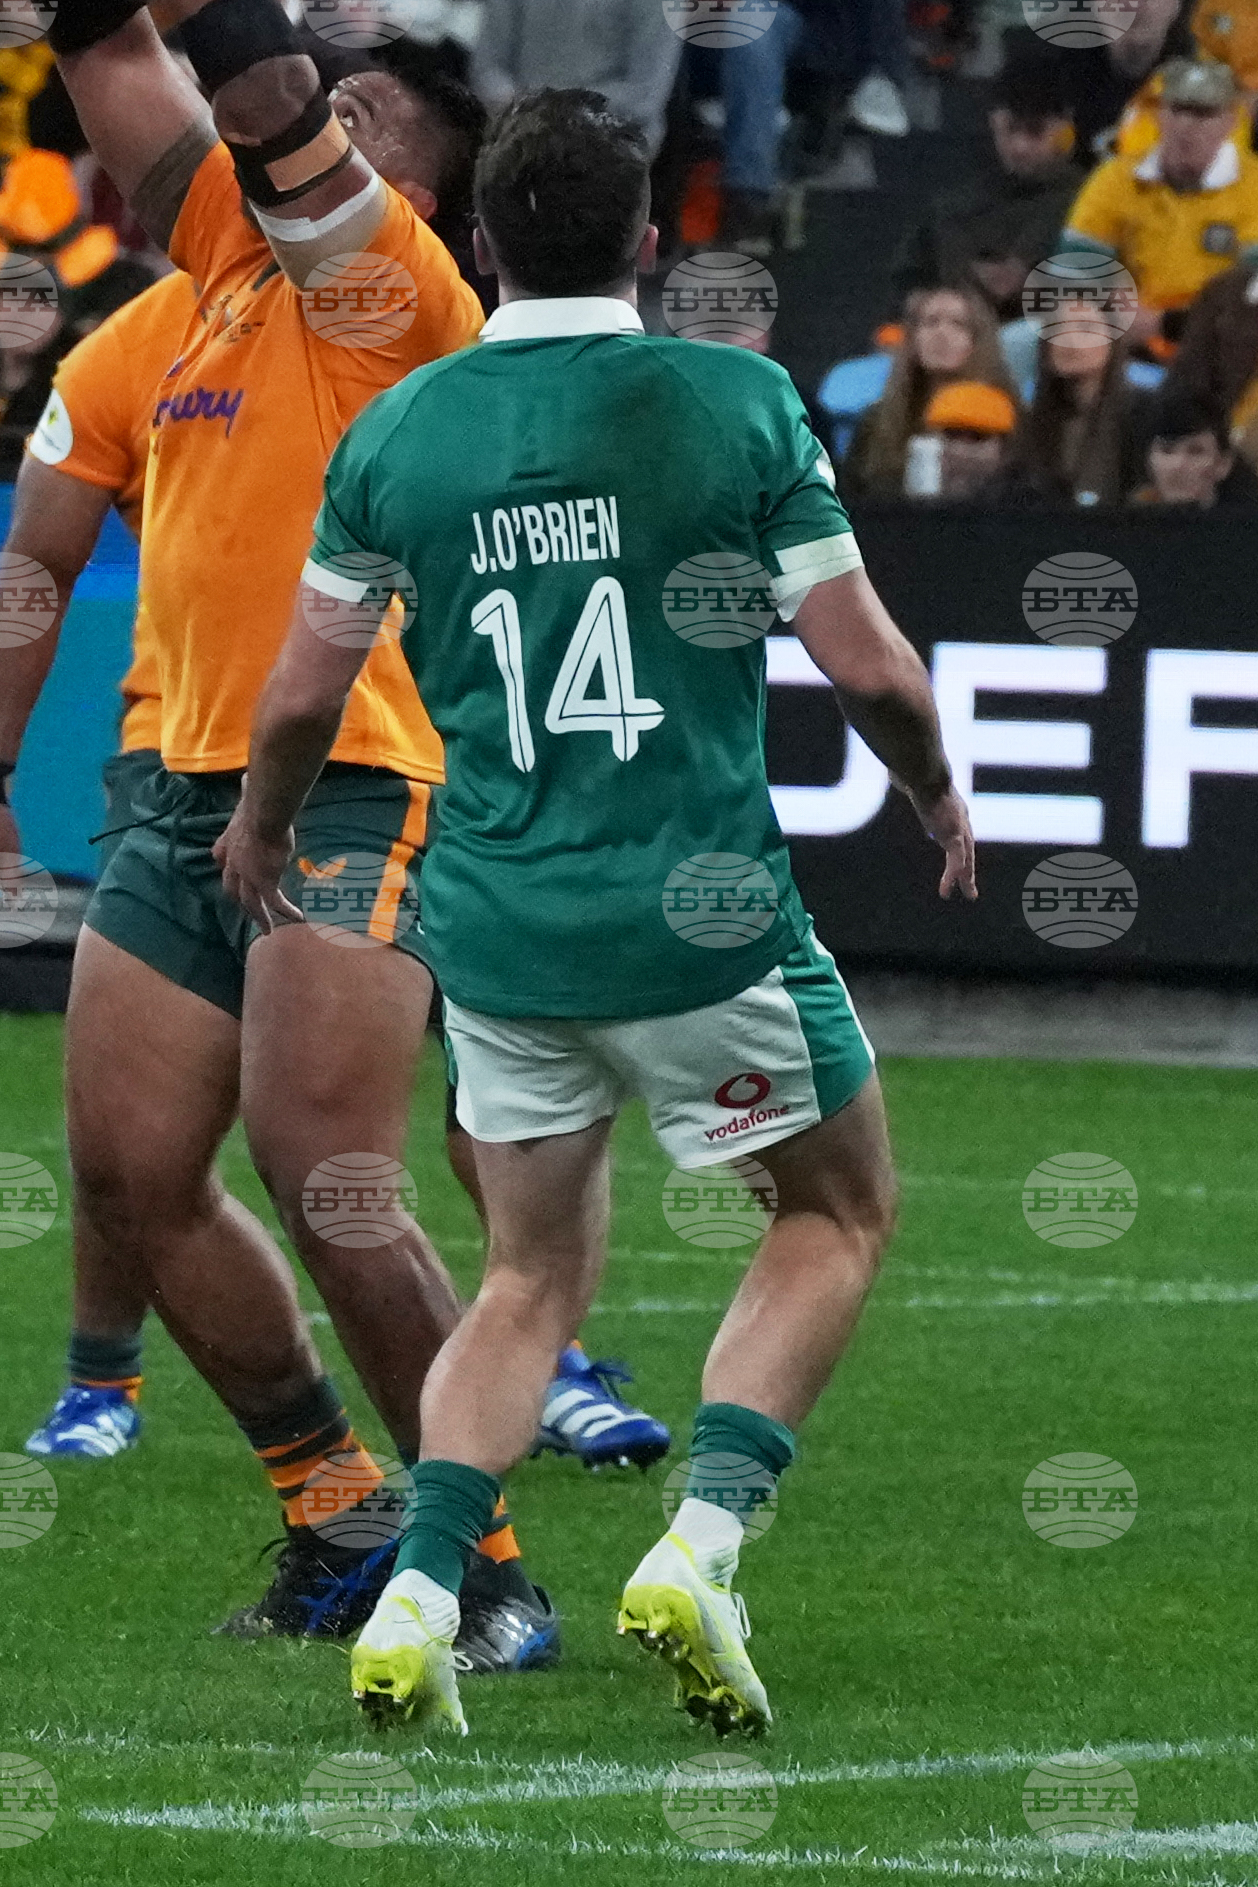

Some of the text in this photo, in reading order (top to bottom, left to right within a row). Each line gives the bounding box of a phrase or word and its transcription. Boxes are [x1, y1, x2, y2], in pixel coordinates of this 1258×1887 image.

[470, 495, 621, 575] J.O'BRIEN
[471, 576, 665, 774] 14
[704, 1104, 790, 1142] vodafone
